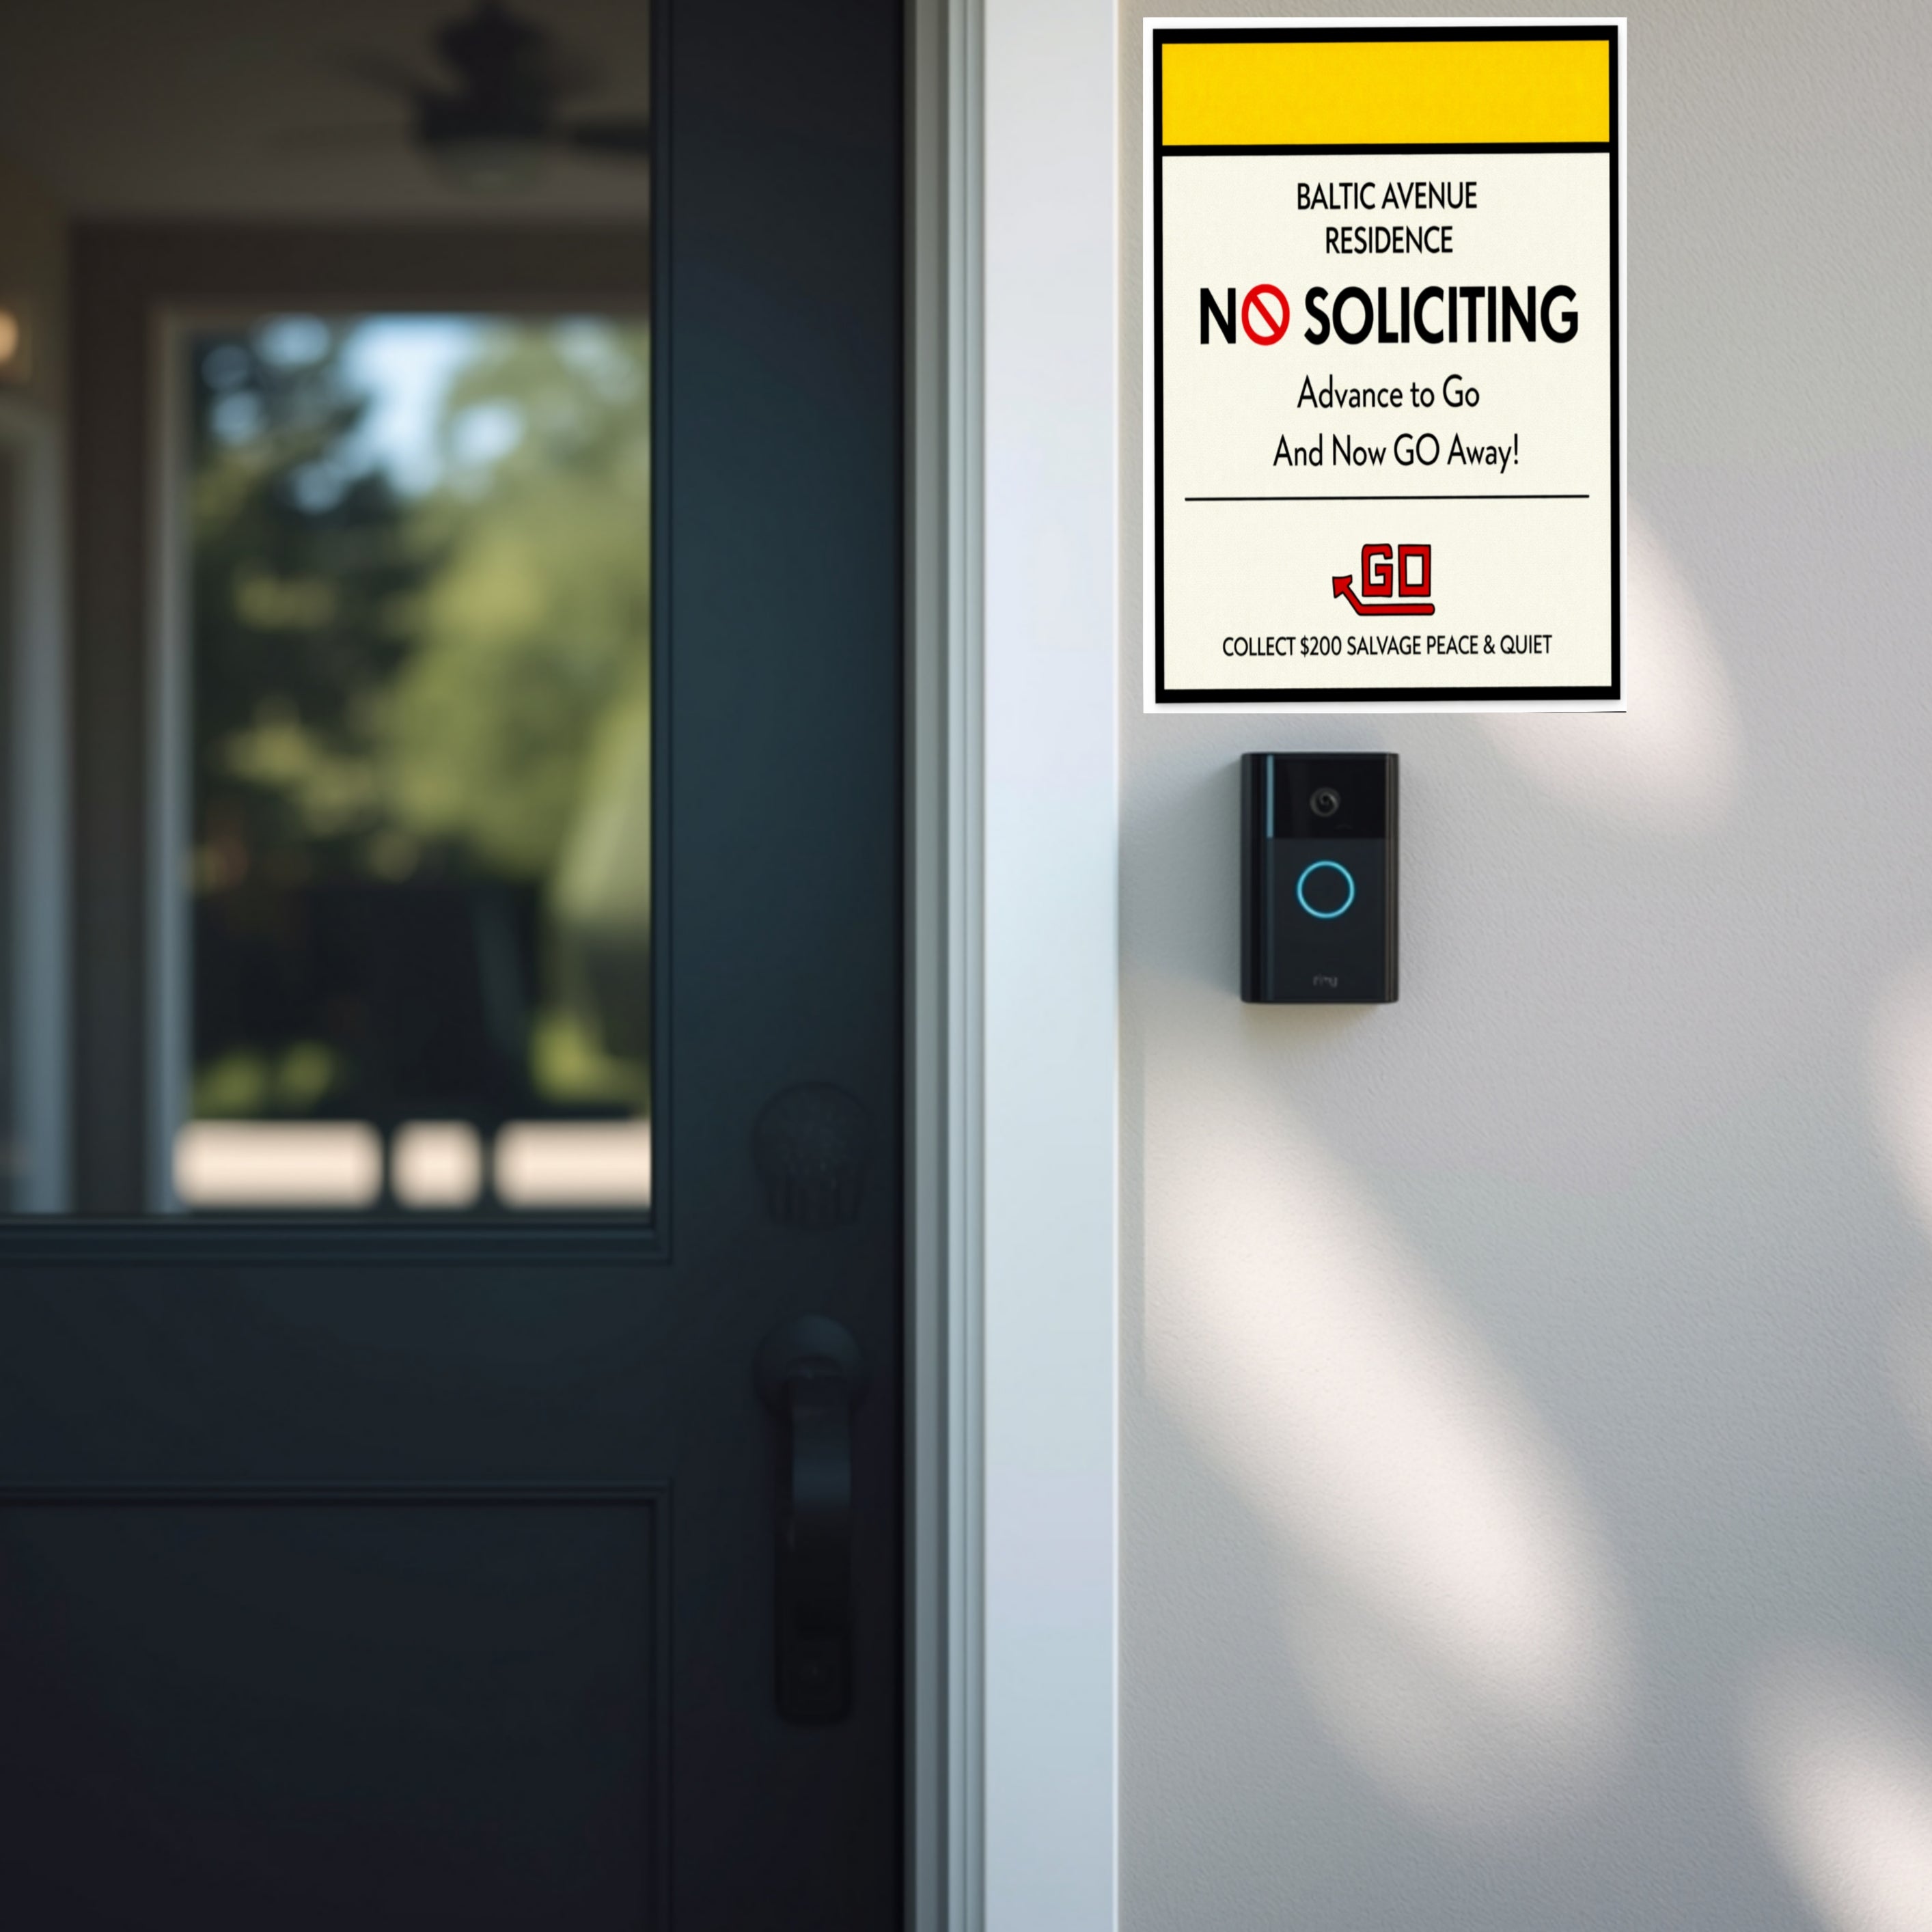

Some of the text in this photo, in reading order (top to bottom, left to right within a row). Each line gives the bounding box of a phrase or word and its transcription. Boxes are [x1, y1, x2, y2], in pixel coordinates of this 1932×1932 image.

[1297, 180, 1478, 210] BALTIC AVENUE
[1325, 225, 1454, 255] RESIDENCE
[1303, 284, 1579, 346] SOLICITING
[1297, 373, 1480, 409] Advance to Go
[1272, 432, 1519, 474] And Now GO Away!
[1362, 543, 1431, 598] GO
[1222, 634, 1553, 658] COLLECT $200 SALVAGE PEACE & QUIET
